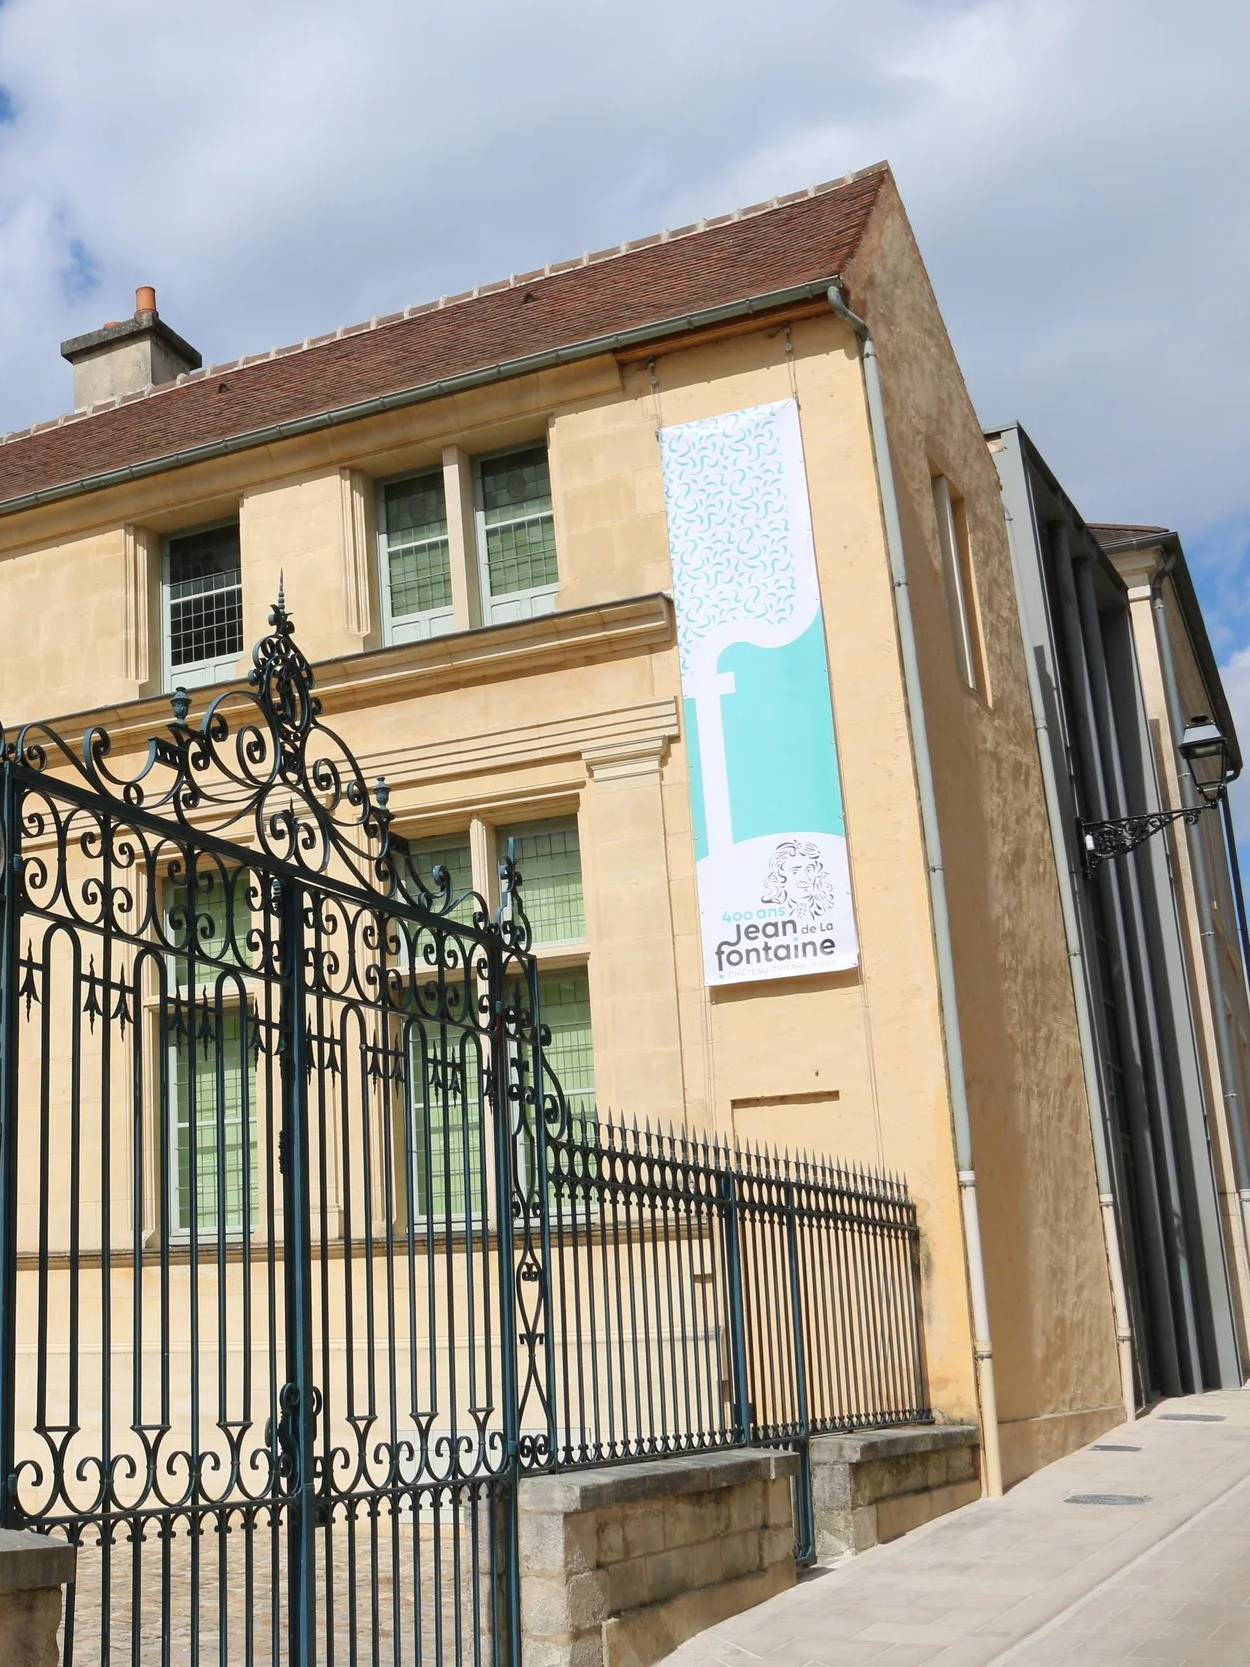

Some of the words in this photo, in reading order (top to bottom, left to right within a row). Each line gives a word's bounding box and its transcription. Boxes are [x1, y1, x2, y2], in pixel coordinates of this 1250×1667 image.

[721, 910, 753, 923] 400
[755, 906, 786, 919] ans
[801, 924, 817, 935] de
[819, 922, 834, 932] La
[715, 937, 836, 972] fontaine
